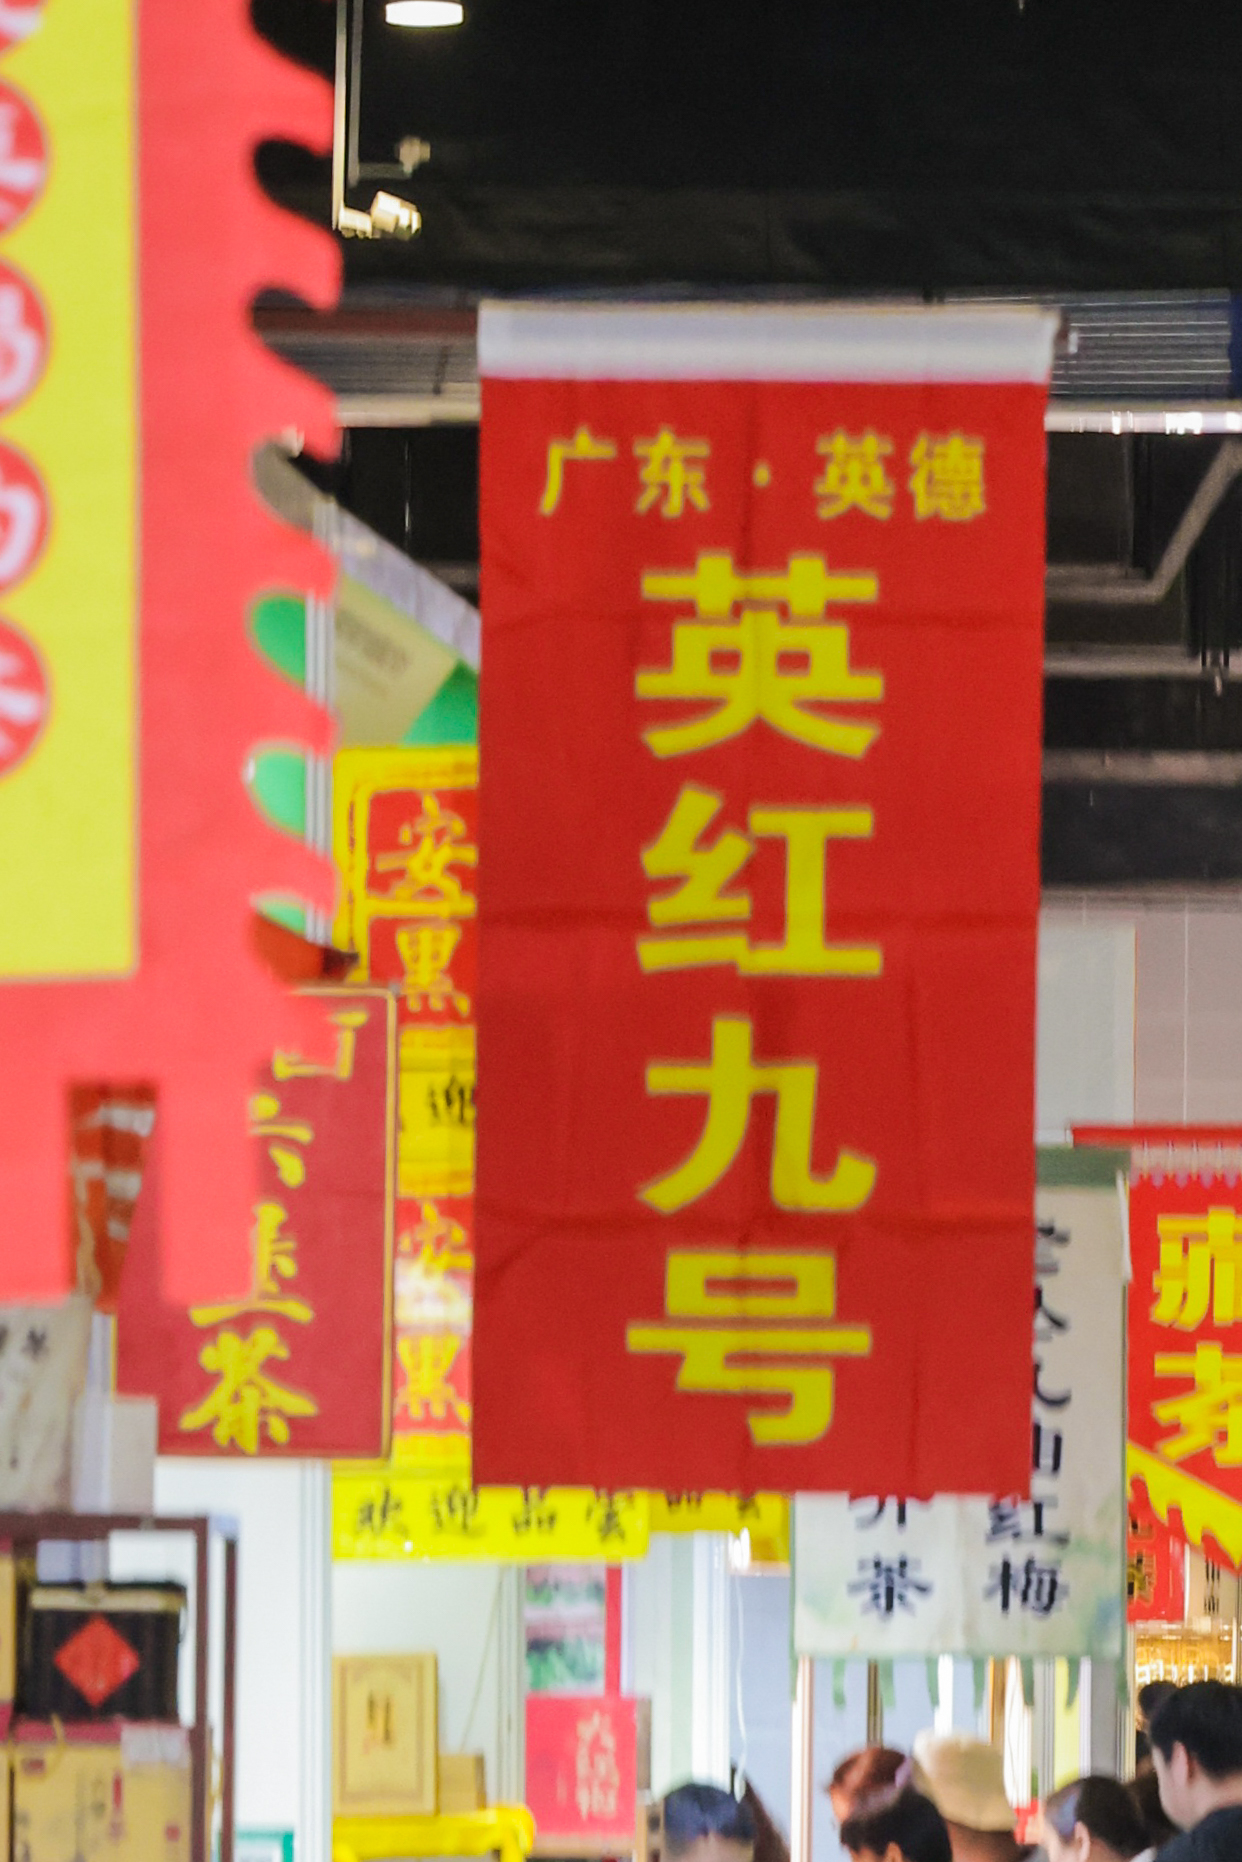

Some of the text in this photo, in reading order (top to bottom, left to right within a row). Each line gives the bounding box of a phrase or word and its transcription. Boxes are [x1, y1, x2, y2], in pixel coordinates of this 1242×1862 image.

[540, 427, 987, 521] 广东·英德
[625, 551, 885, 1446] 英红九号
